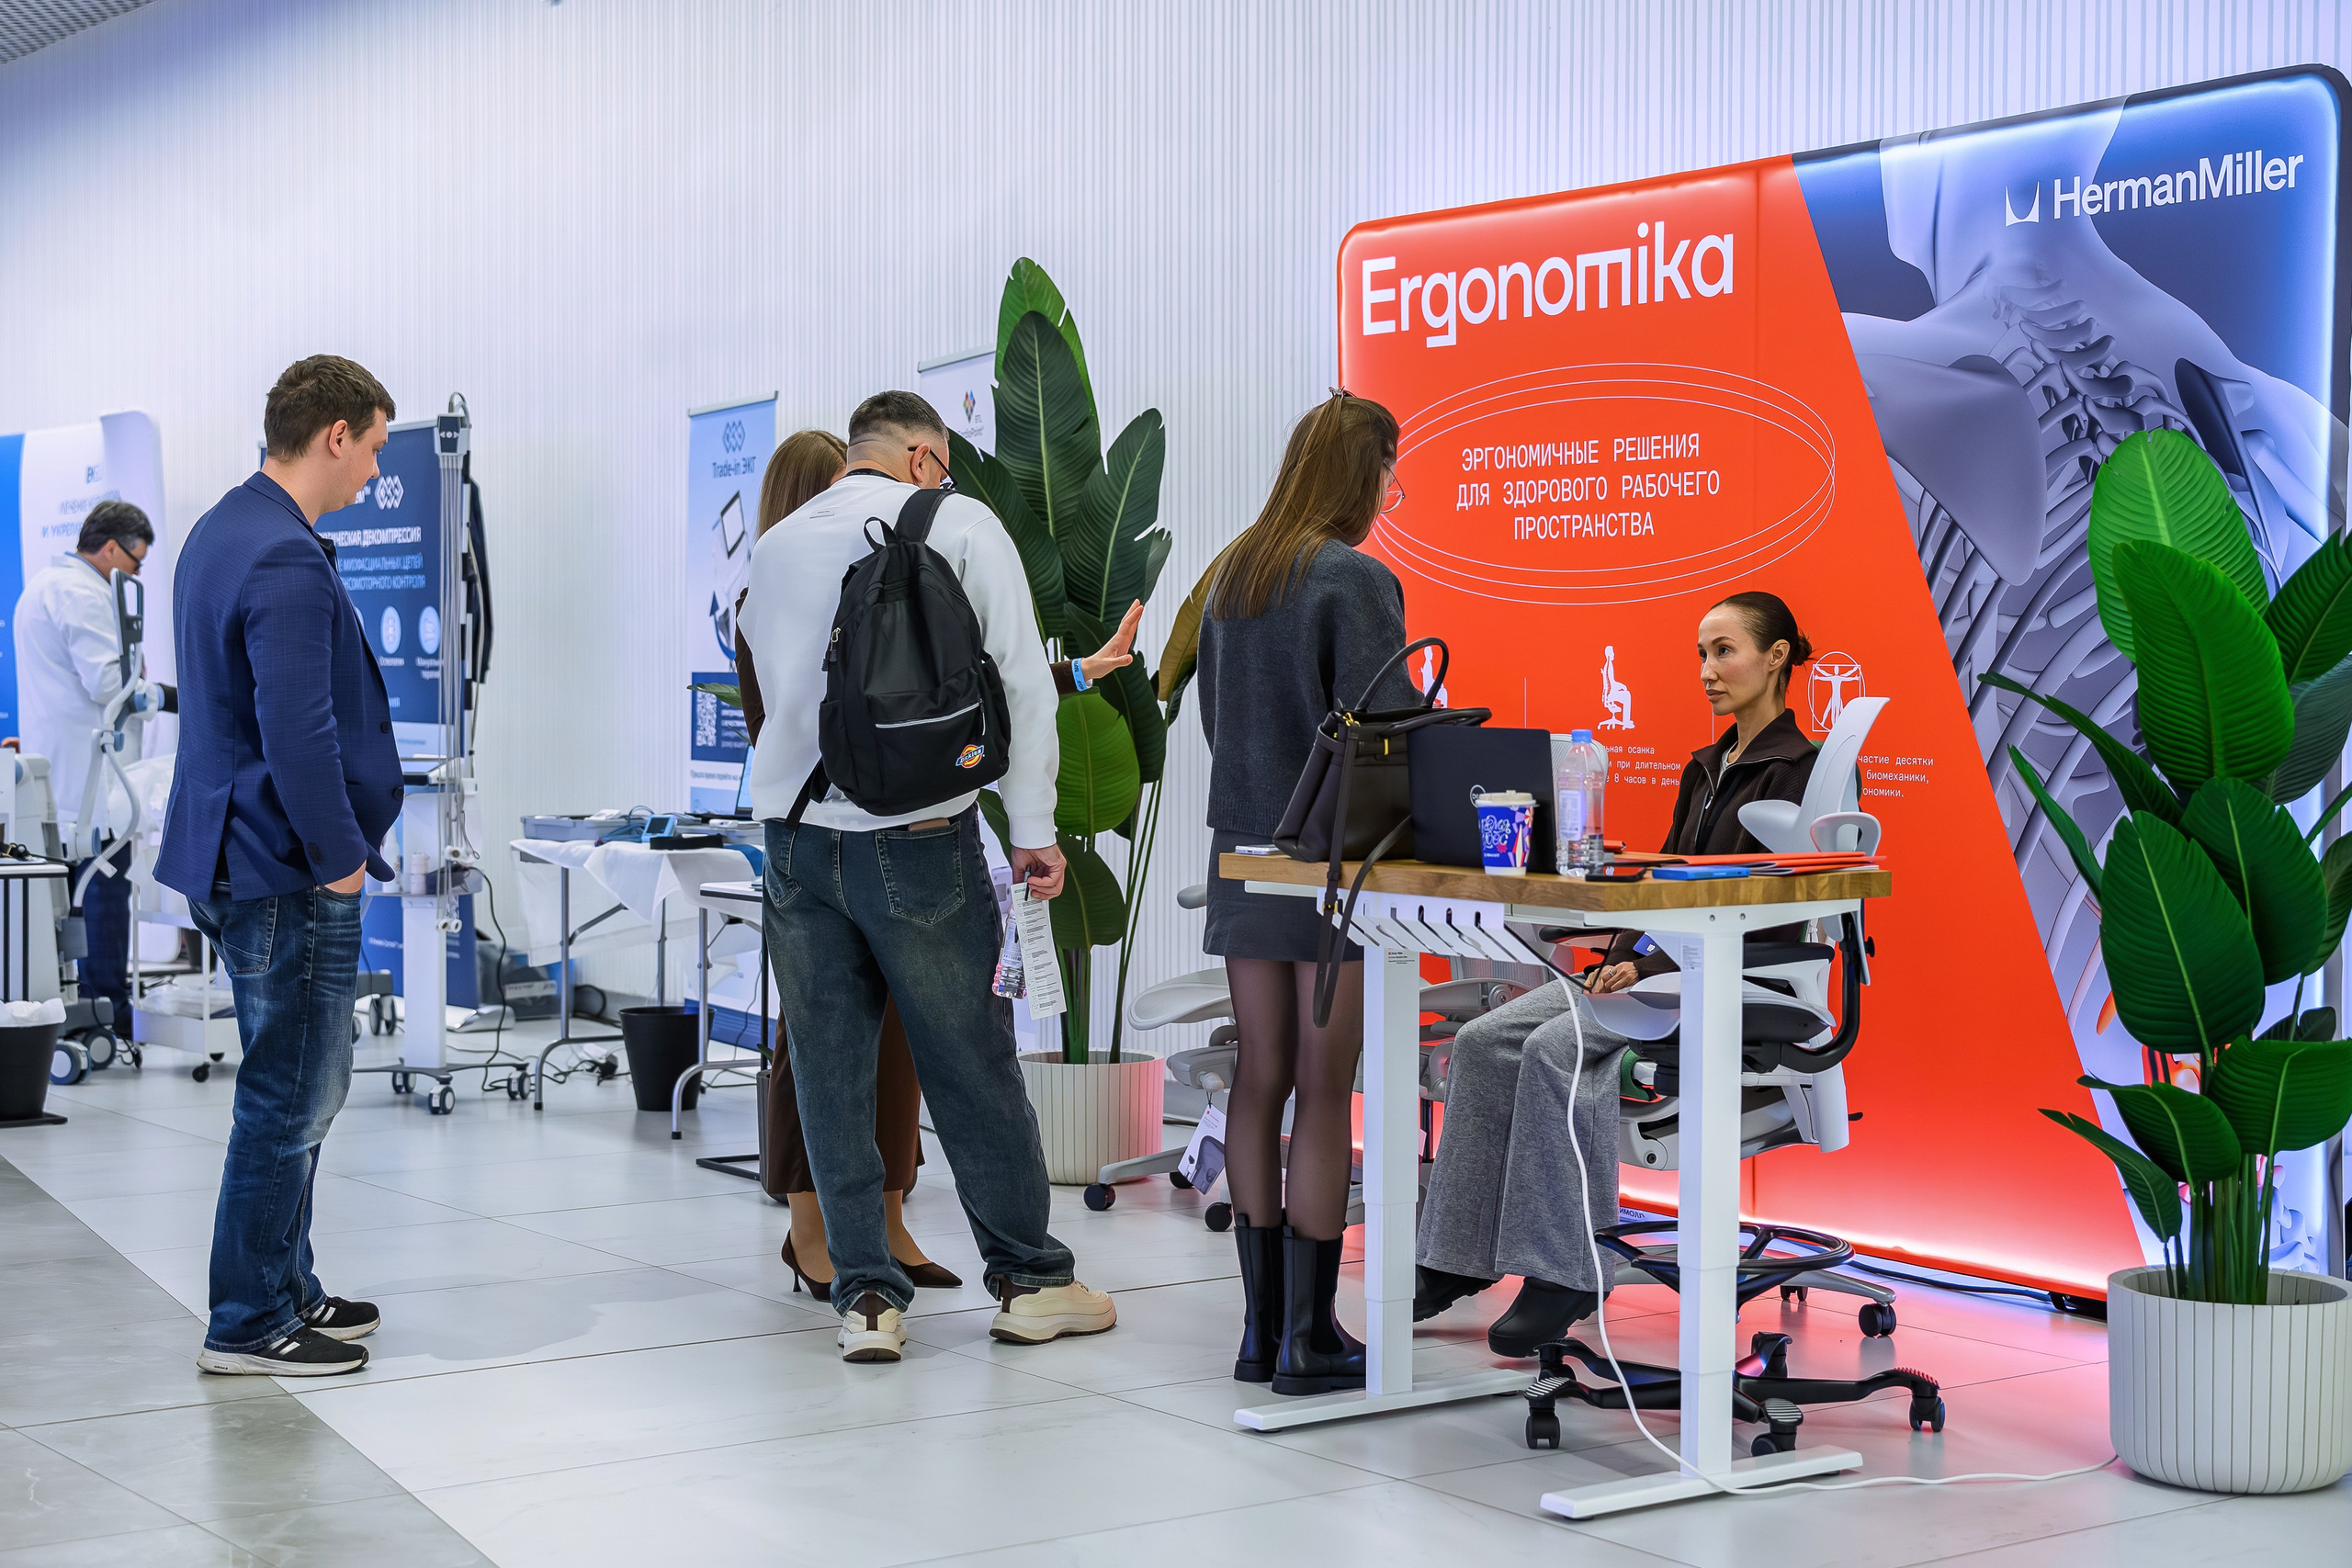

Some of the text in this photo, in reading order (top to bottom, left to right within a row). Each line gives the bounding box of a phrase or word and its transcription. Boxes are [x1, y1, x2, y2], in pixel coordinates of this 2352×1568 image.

[2053, 150, 2304, 220] HermanMiller
[1362, 220, 1735, 348] Ergonomika
[1461, 432, 1700, 472] ЭРГОНОМИЧНЫЕ РЕШЕНИЯ
[712, 459, 741, 479] Trade-in
[1456, 469, 1721, 512] ДЛЯ ЗДОРОВОГО РАБОЧЕГО
[1513, 510, 1655, 541] ПРОСТРАНСТВА
[361, 525, 422, 548] ДЕКОМПРЕССИЯ
[1627, 746, 1655, 754] осанка
[1617, 761, 1631, 770] при
[1634, 761, 1681, 771] длительном
[1895, 756, 1934, 766] десятки
[1614, 773, 1620, 783] 8
[1624, 776, 1646, 784] часов
[1661, 778, 1679, 786] день
[1866, 769, 1929, 784] биомеханики,
[1861, 787, 1905, 797] ономики.
